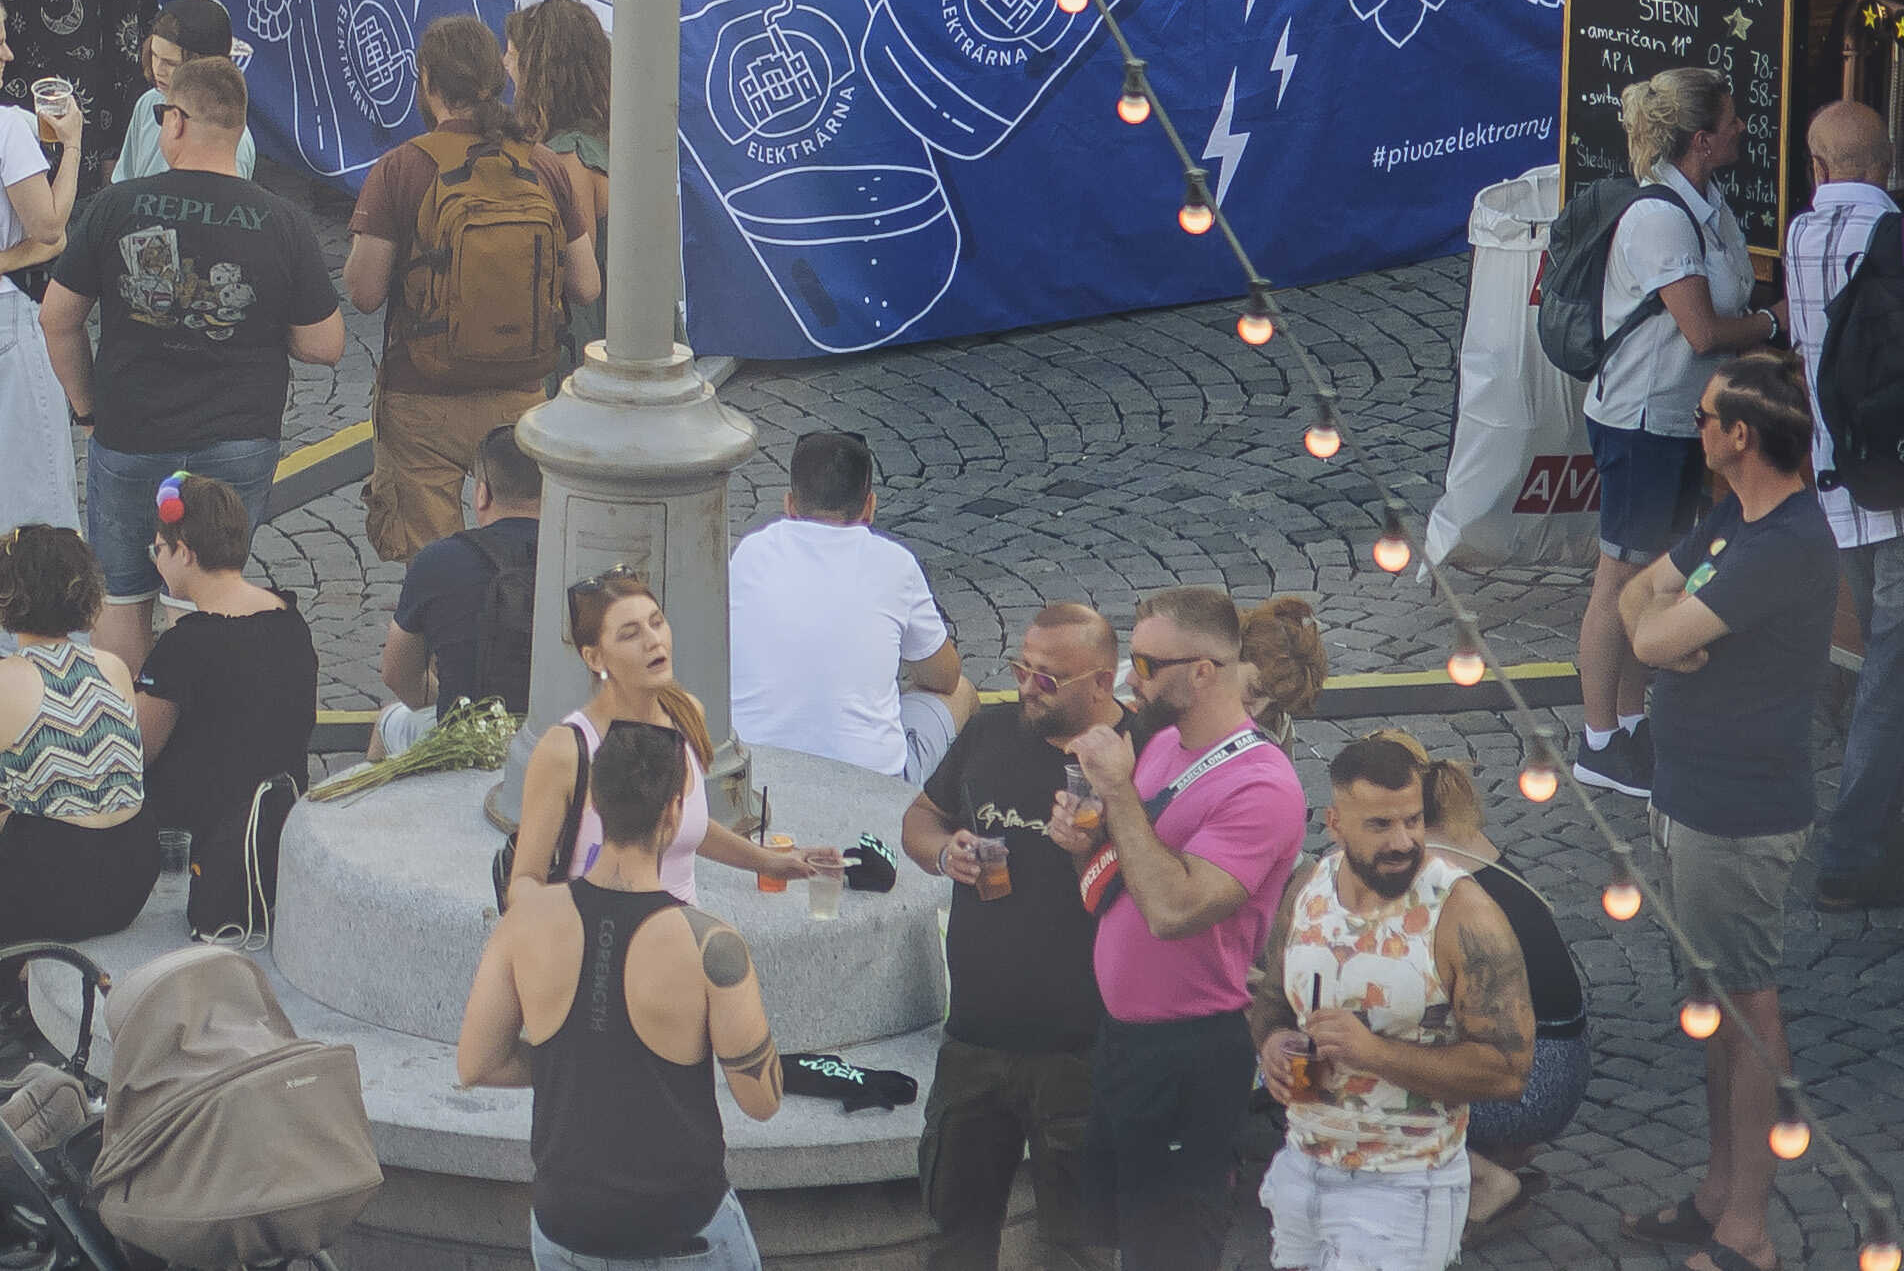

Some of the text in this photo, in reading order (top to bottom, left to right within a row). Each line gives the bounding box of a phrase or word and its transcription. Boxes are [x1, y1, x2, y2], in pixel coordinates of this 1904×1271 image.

[1587, 25, 1667, 53] američan
[1602, 48, 1635, 75] APA
[746, 85, 857, 165] ELEKTRÁRNA
[1372, 115, 1553, 173] #pivozelektrarny
[129, 192, 273, 231] REPLAY
[1175, 747, 1229, 793] BARCELONA
